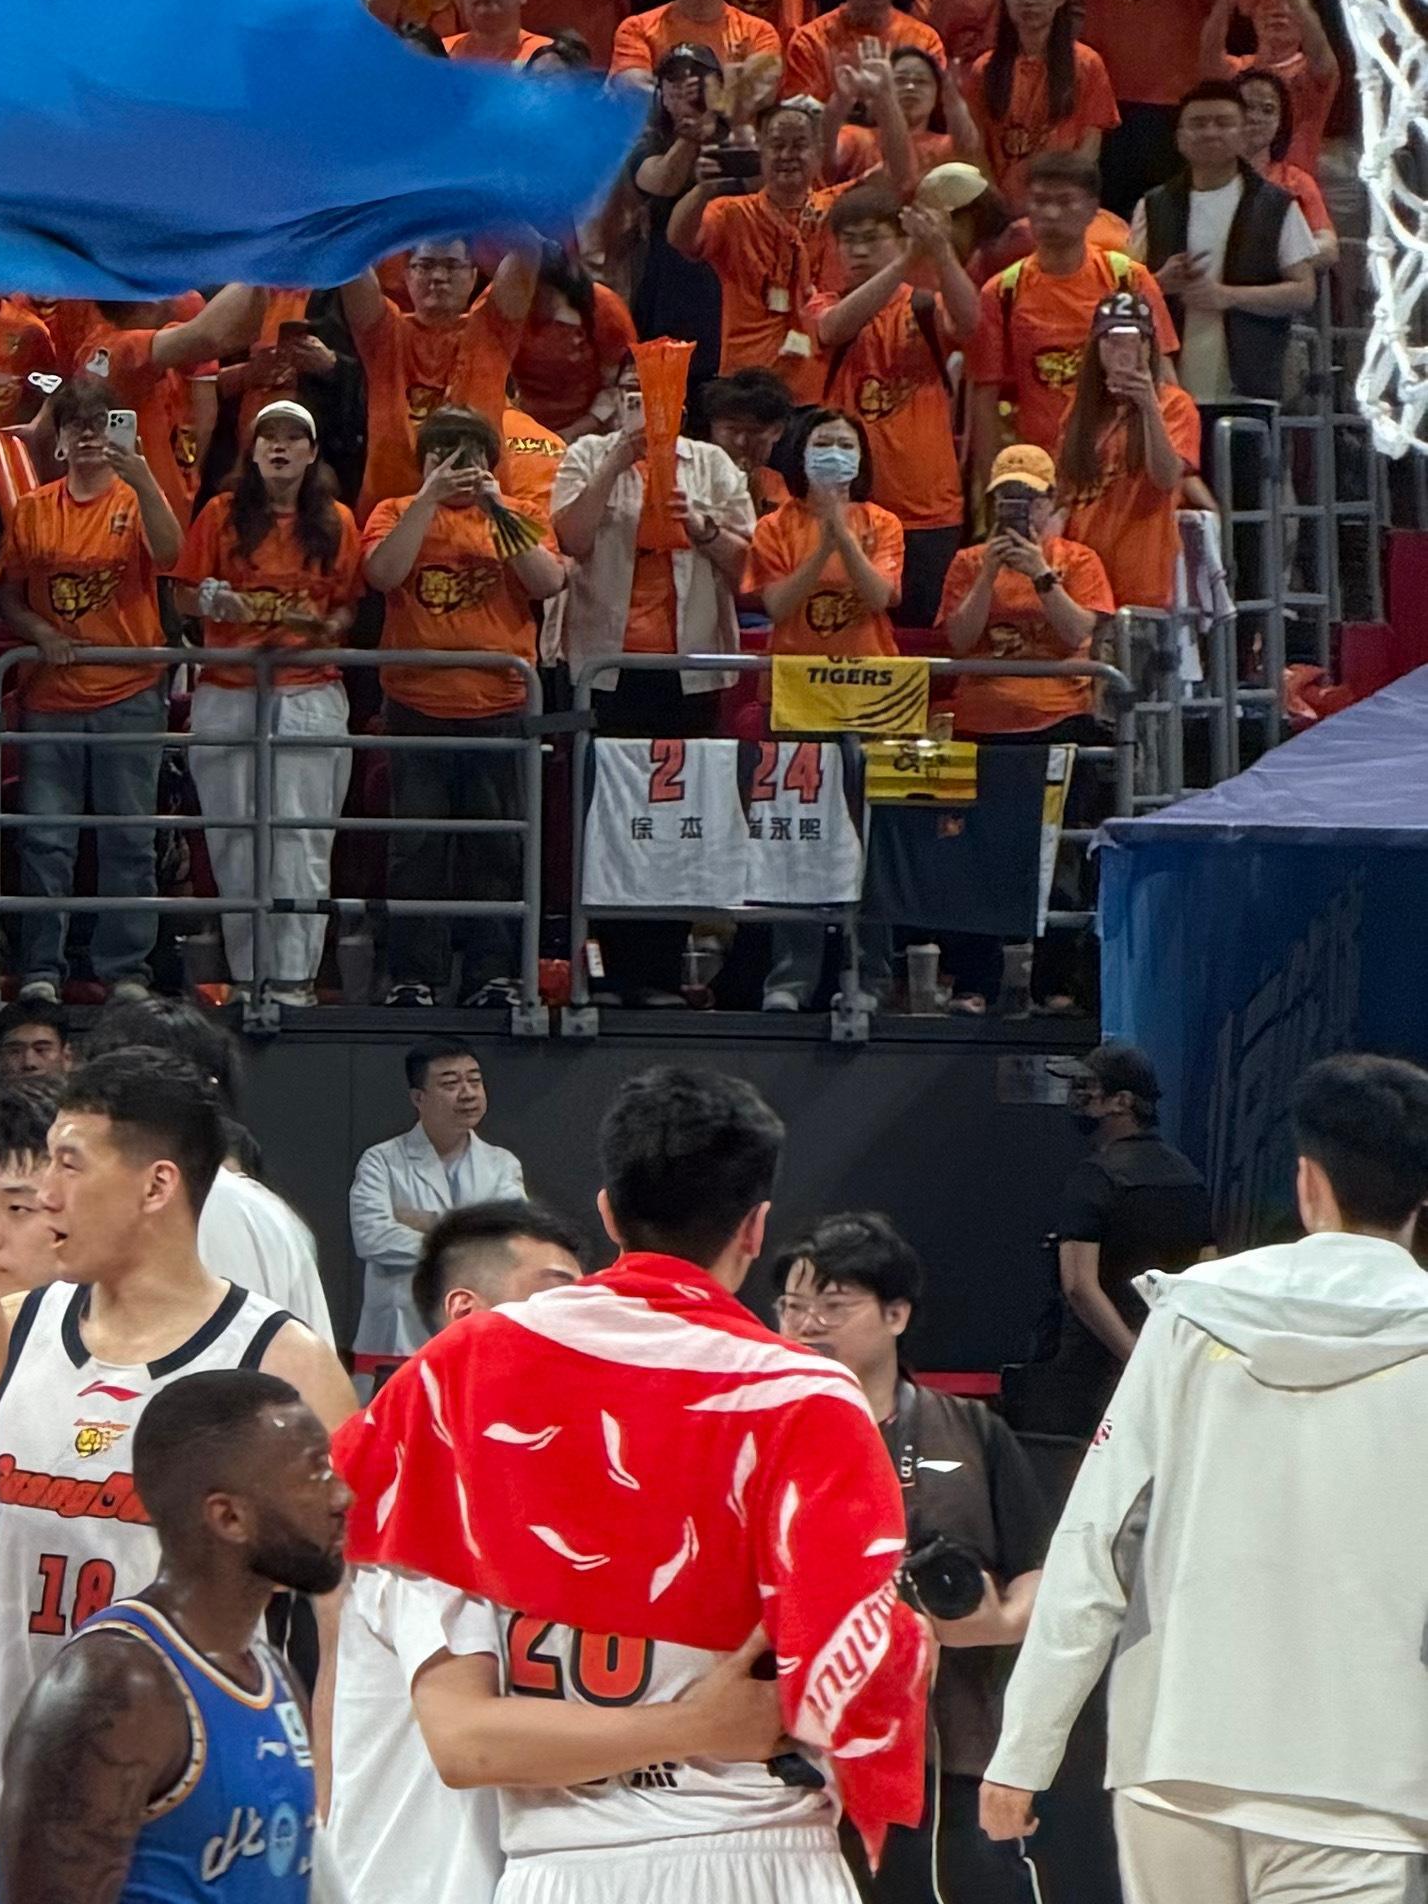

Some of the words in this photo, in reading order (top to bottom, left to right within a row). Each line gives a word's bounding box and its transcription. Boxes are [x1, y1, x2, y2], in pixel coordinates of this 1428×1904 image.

[1114, 291, 1135, 316] 2
[807, 666, 894, 687] TIGERS
[647, 738, 686, 803] 2
[749, 740, 823, 803] 24
